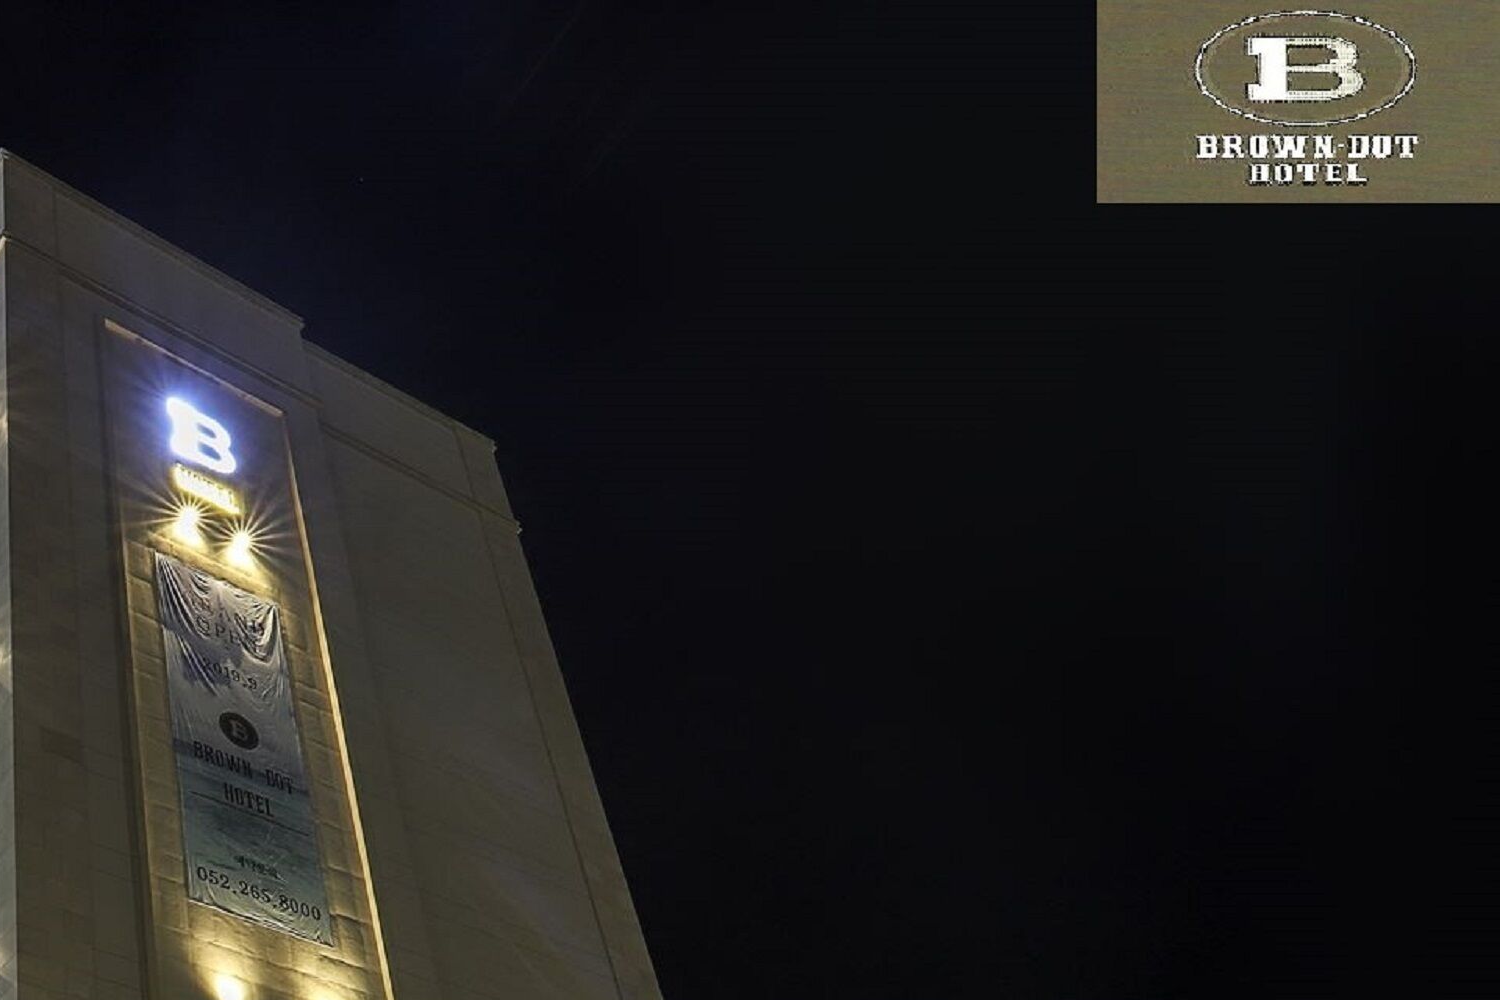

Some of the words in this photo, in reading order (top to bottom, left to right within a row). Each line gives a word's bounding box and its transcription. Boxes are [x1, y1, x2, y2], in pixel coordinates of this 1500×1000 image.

[166, 397, 237, 474] B
[223, 782, 274, 818] HOTEL
[197, 866, 321, 921] 052.265.8000
